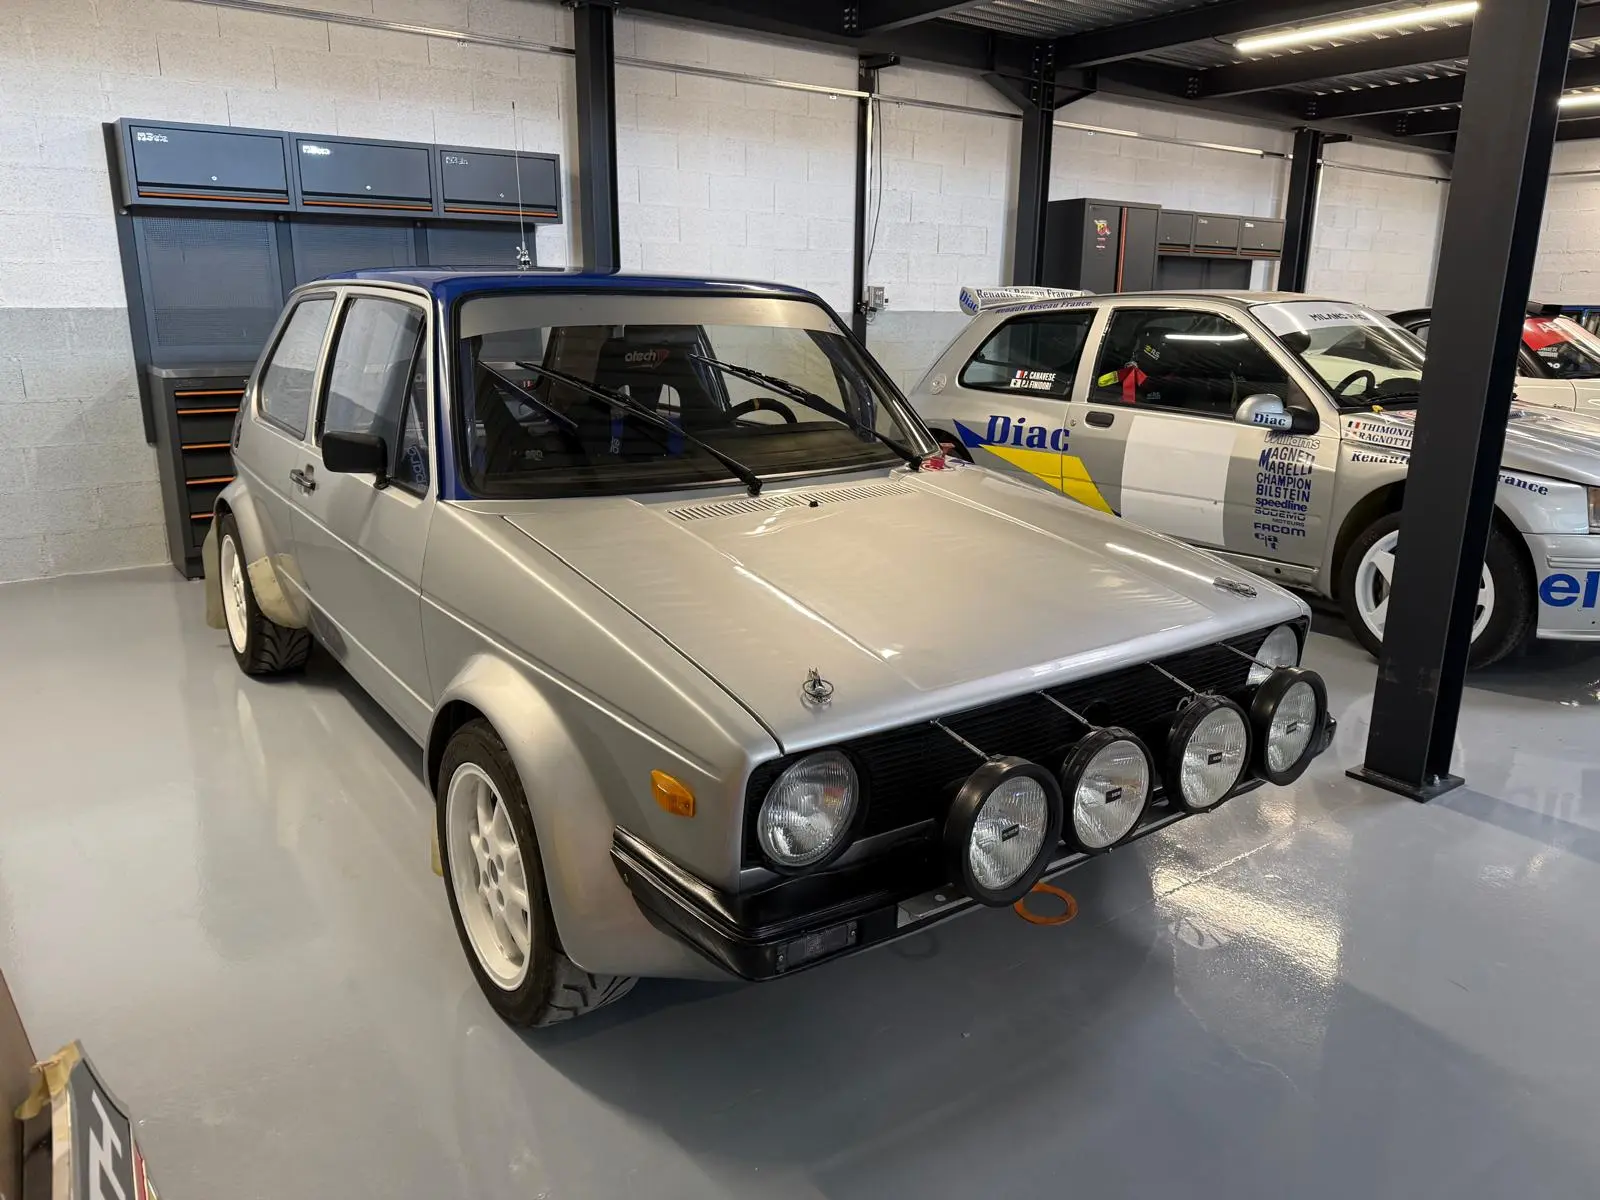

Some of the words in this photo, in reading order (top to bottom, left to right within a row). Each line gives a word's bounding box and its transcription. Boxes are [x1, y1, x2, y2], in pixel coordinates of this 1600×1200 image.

[960, 289, 979, 313] Diac
[1046, 289, 1075, 298] France
[1060, 300, 1092, 308] France
[1253, 413, 1287, 426] Diac
[986, 415, 1070, 452] Diac
[1359, 431, 1412, 447] RAGNOTTI
[1258, 459, 1313, 477] MARELLI
[1256, 472, 1312, 491] CHAMPION
[1255, 483, 1311, 503] BILSTEIN
[1255, 497, 1308, 513] speedline
